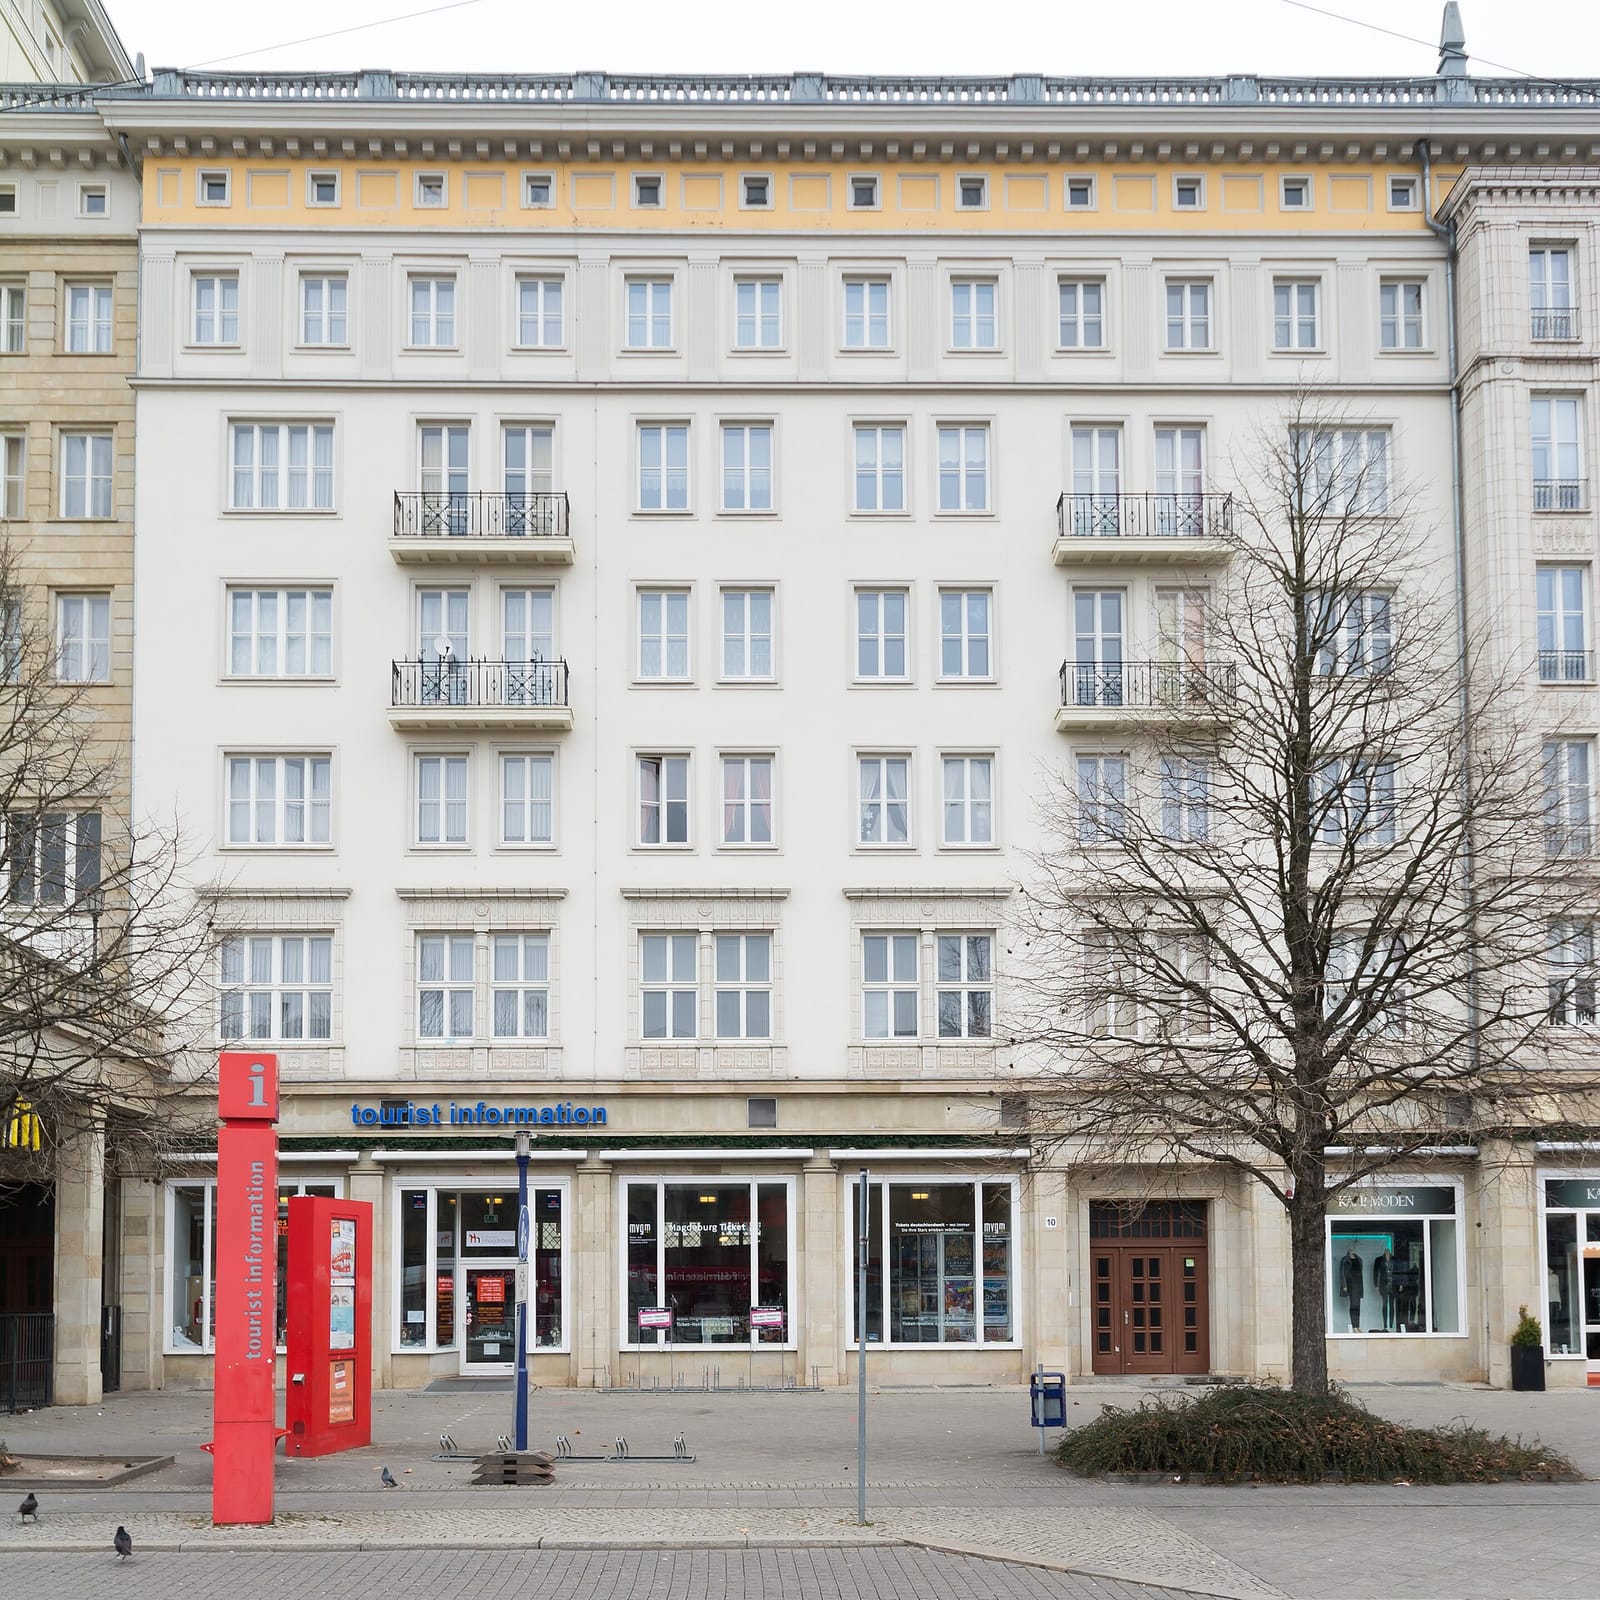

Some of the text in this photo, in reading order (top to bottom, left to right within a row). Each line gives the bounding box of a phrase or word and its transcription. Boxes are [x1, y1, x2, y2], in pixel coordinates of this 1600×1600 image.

[248, 1063, 269, 1107] i
[351, 1101, 608, 1125] tourist information
[1370, 1195, 1415, 1207] MODEN
[670, 1222, 746, 1232] Magdeburg Ticket
[984, 1222, 1006, 1234] mvgm
[1046, 1218, 1056, 1227] 10
[629, 1223, 651, 1235] mvgm
[244, 1161, 264, 1360] tourist information
